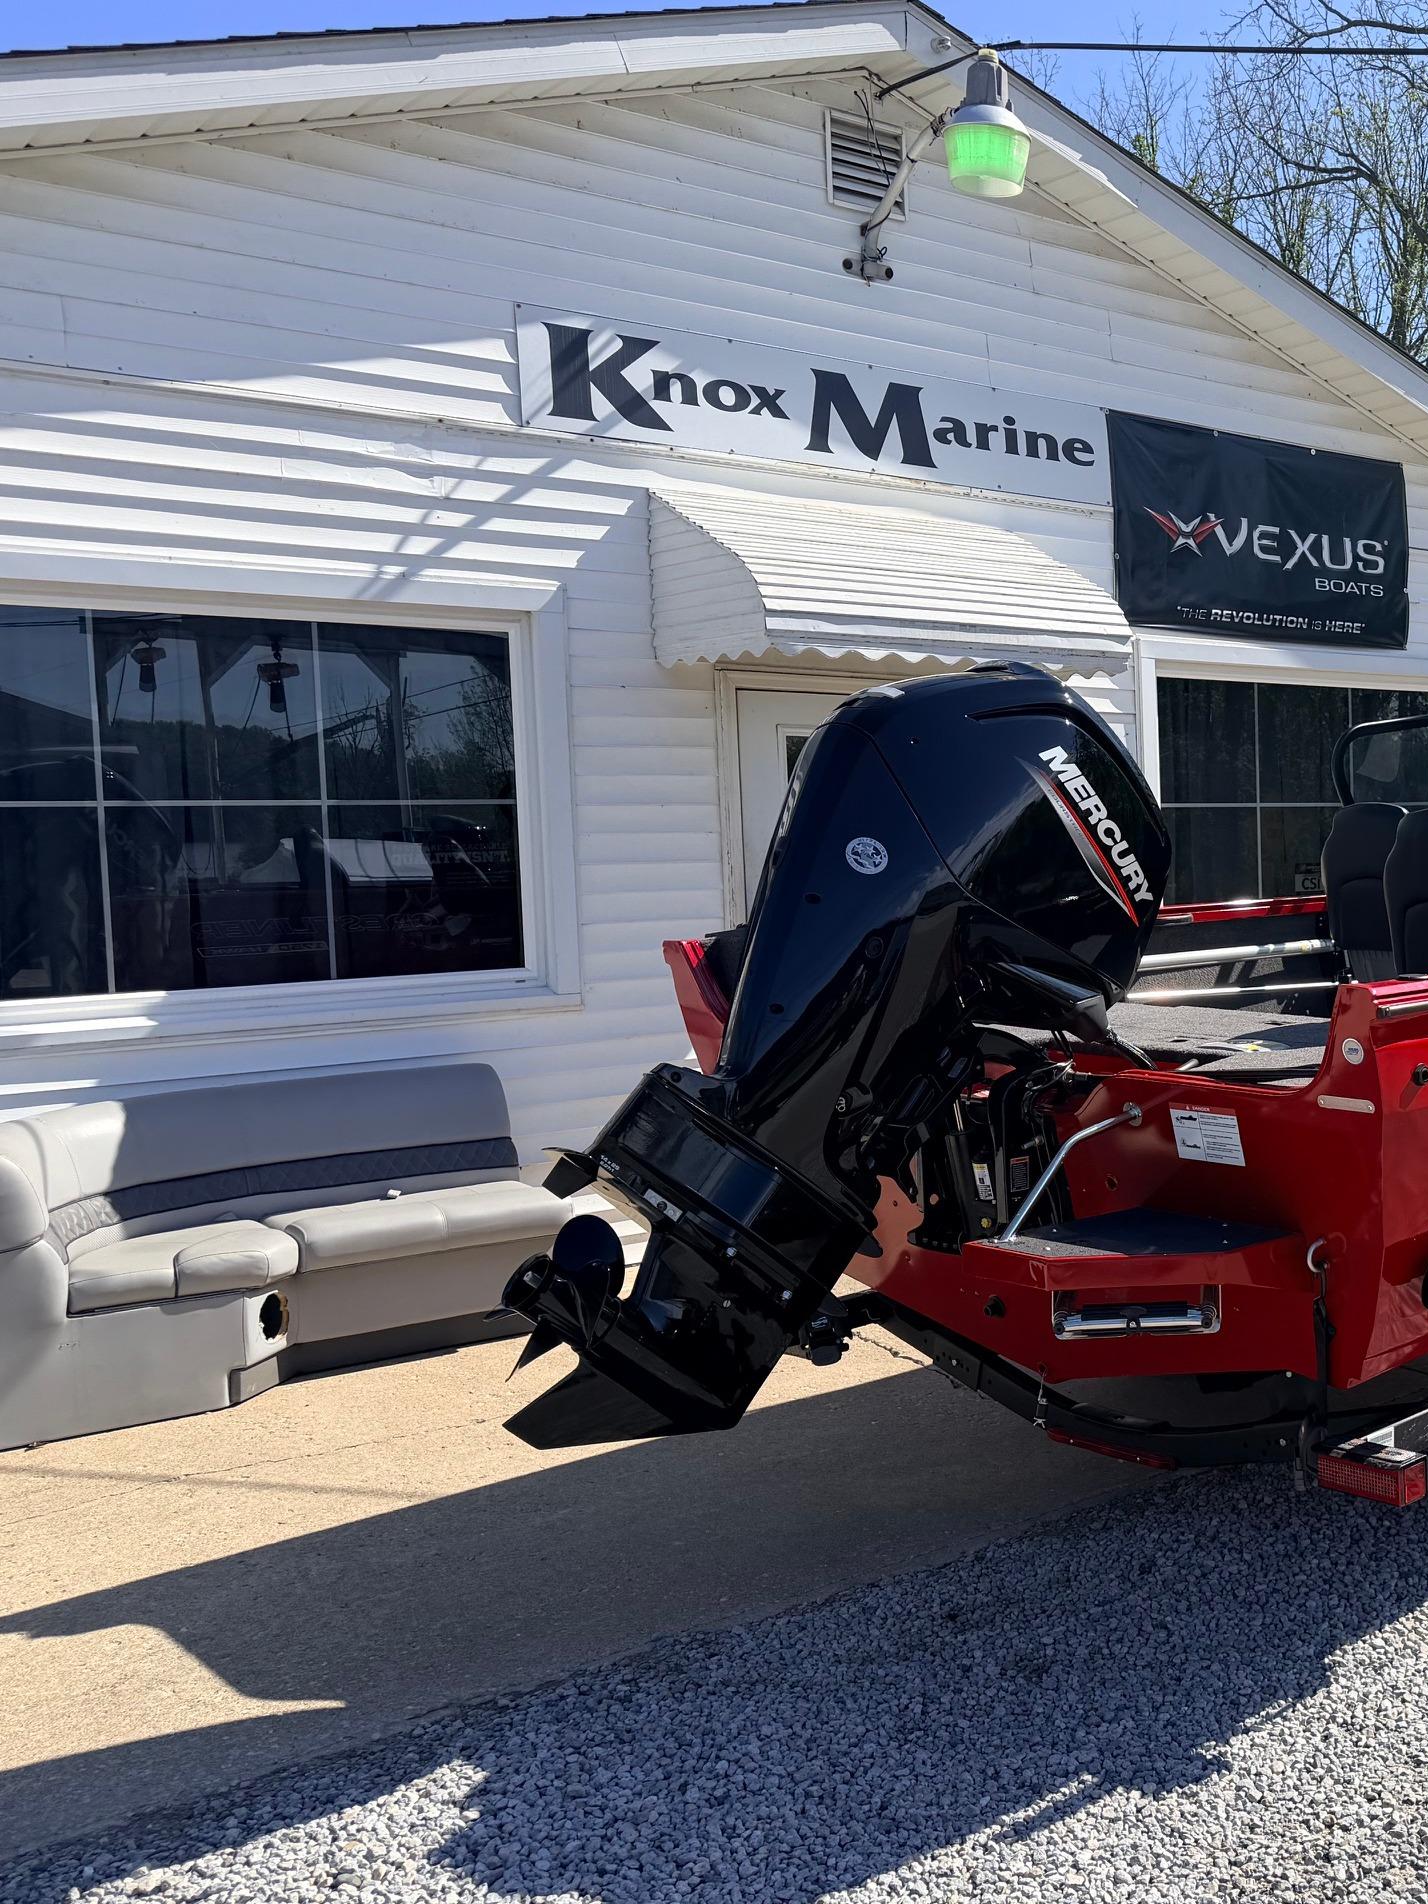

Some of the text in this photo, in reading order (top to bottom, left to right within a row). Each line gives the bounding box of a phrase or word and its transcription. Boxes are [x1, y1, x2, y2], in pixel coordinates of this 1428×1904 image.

[540, 321, 1096, 470] Knox Marine
[1206, 512, 1386, 575] VEXUS
[1314, 577, 1384, 597] BOATS
[1210, 608, 1308, 629] REVOLUTION
[1311, 619, 1322, 631] IS
[1038, 745, 1153, 903] MERCURY
